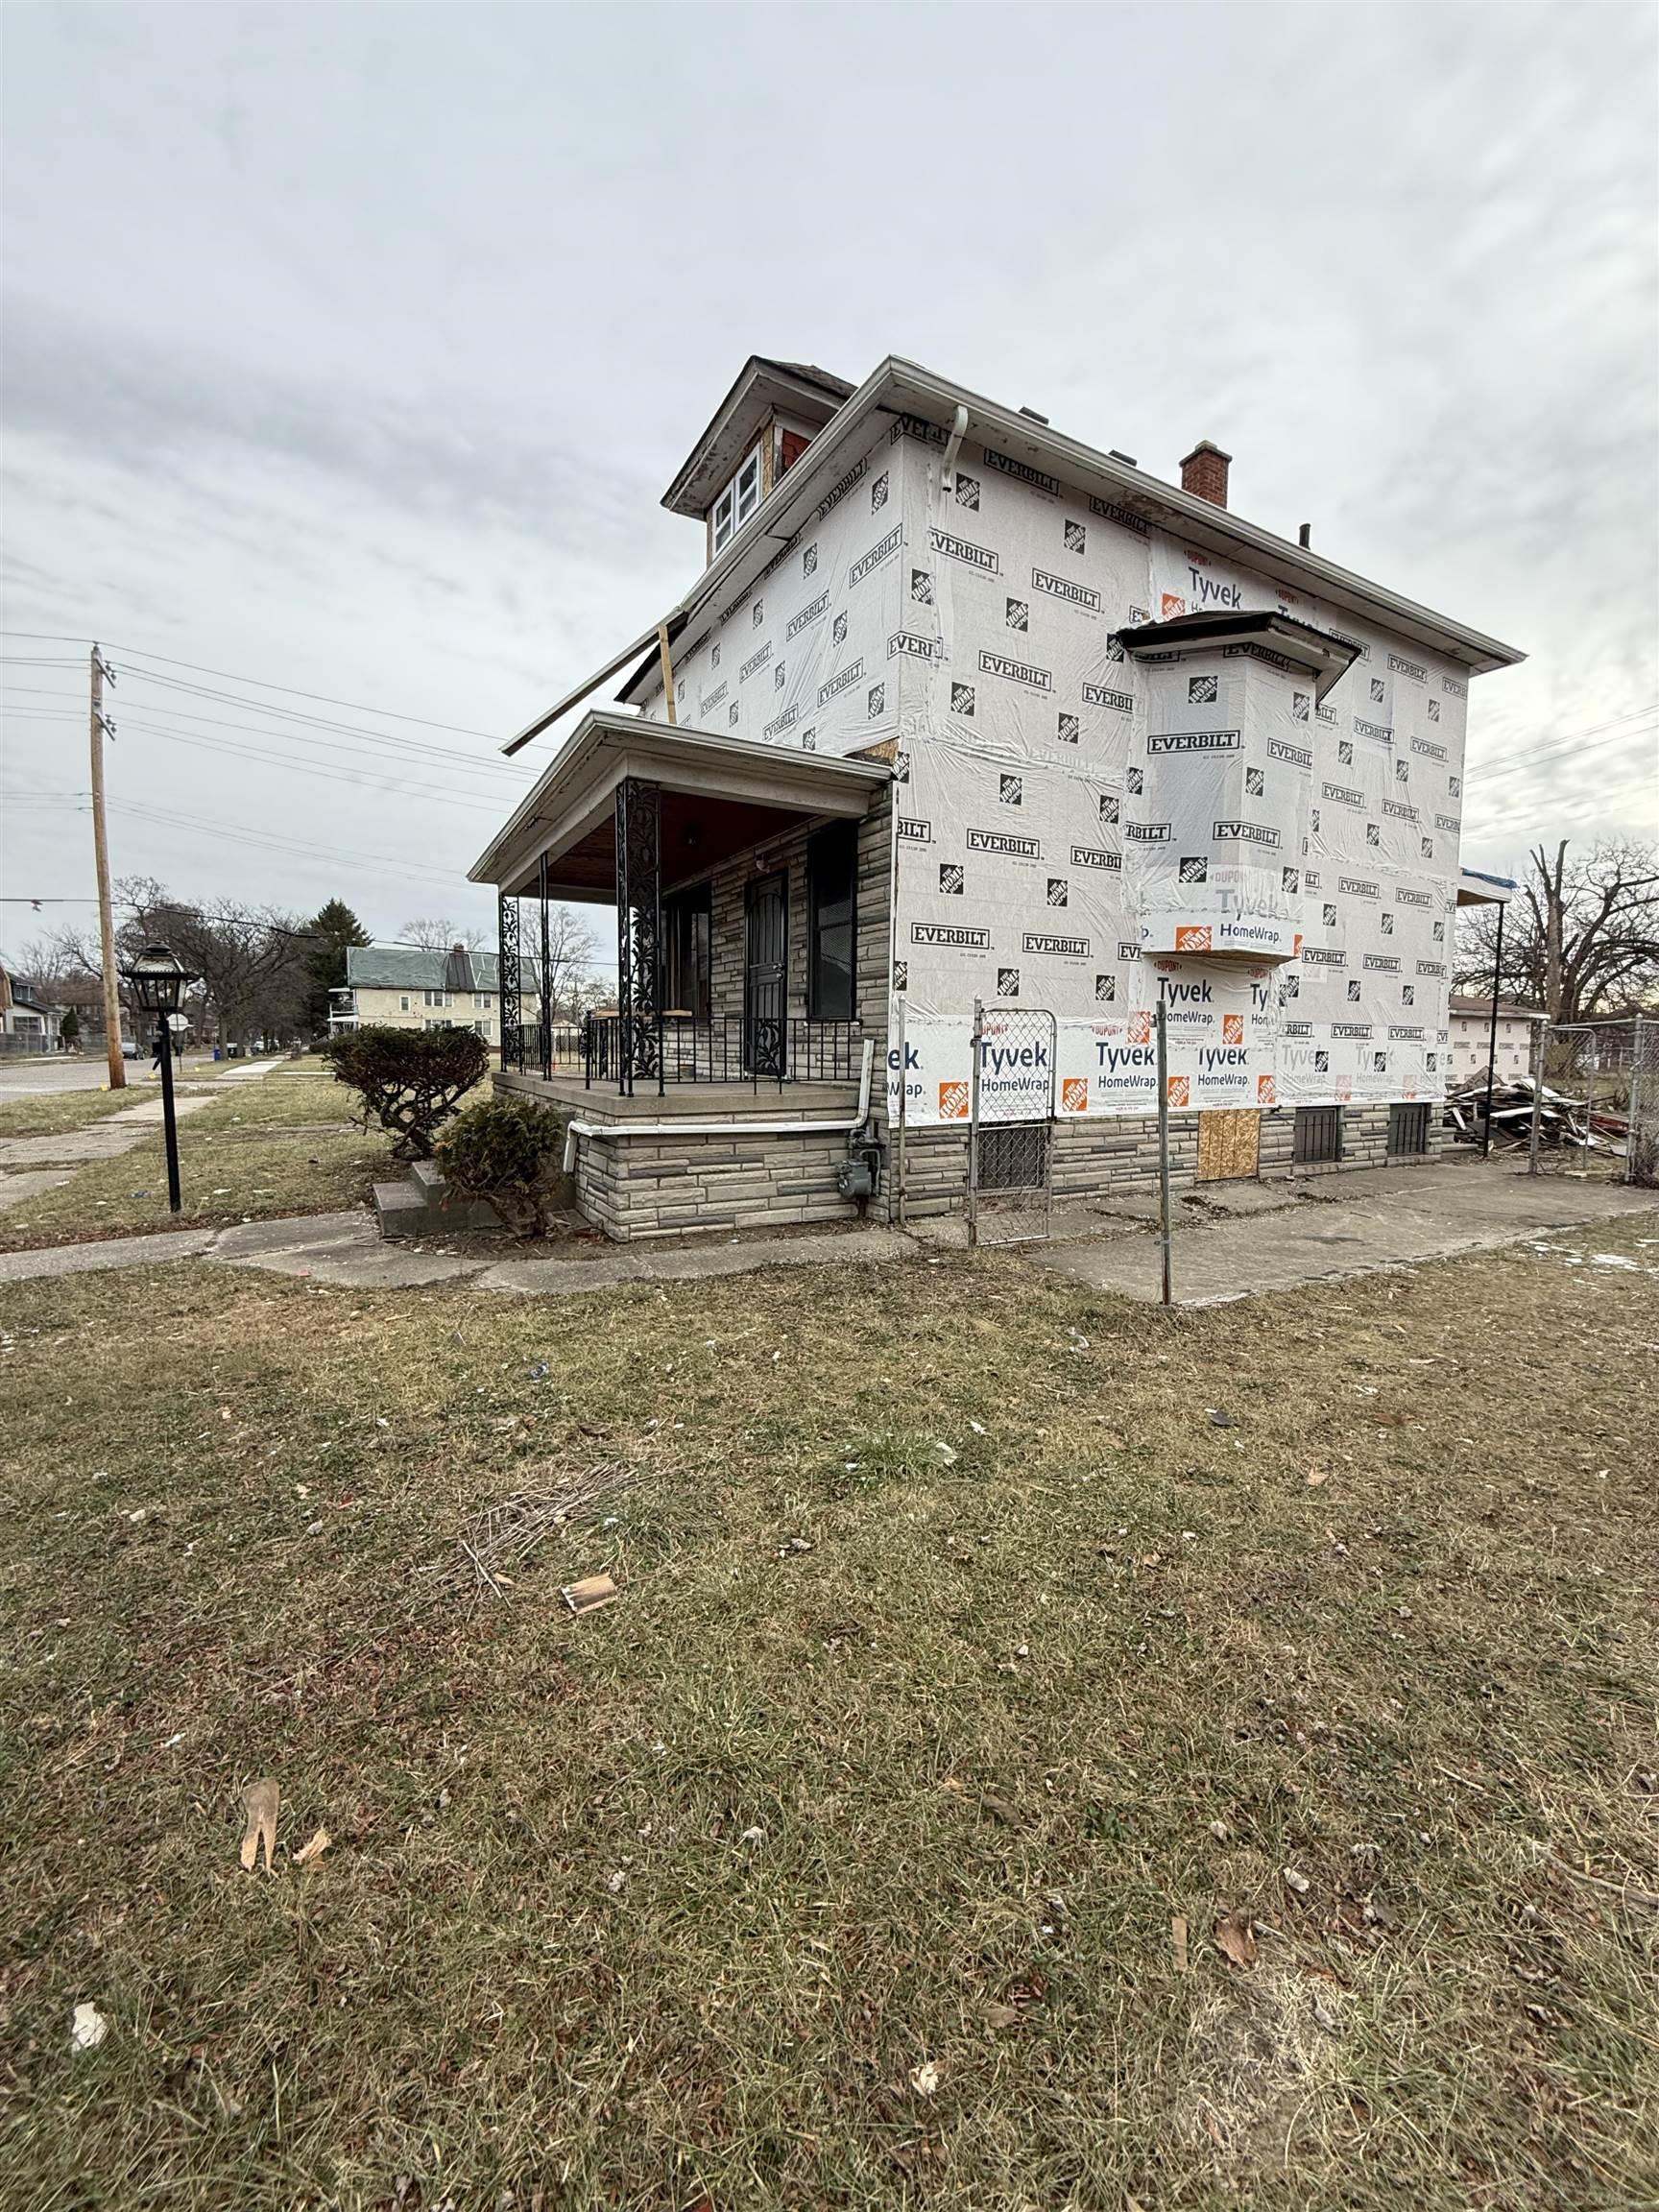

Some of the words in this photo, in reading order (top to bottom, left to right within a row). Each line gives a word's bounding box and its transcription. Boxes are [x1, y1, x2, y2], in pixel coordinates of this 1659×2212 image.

[987, 452, 1054, 491] EVERBILT
[852, 529, 900, 583] EVERBILT
[1035, 572, 1098, 608] EVERBILT
[1189, 566, 1241, 609] Tyvek
[788, 594, 828, 637] EVERBILT
[981, 653, 1049, 686] EVERBILT
[819, 663, 861, 703] EVERBILT
[1189, 677, 1217, 703] HOME
[764, 708, 797, 740] EVERBILT
[1355, 721, 1392, 740] EVERBILT
[1151, 733, 1236, 751] EVERBILT
[1412, 740, 1445, 758] EVERBILT
[1324, 785, 1362, 805] EVERBILT
[1383, 803, 1418, 820] EVERBILT
[970, 833, 1037, 855] EVERBILT
[1216, 825, 1278, 846] EVERBILT
[940, 866, 963, 892] HOME
[1180, 858, 1207, 882] HOME
[1340, 880, 1378, 895] EVERBILT
[1397, 891, 1431, 904] EVERBILT
[914, 926, 987, 946] EVERBILT
[1220, 924, 1280, 943] HomeWrap
[1025, 937, 1087, 954] EVERBILT
[1157, 962, 1179, 972] DUPONT
[1304, 950, 1345, 963] EVERBILT
[1364, 957, 1399, 969] EVERBILT
[998, 970, 1019, 995] HOME
[1158, 977, 1212, 1007] Tyvek
[1163, 1012, 1214, 1024] omeWrap
[1334, 1026, 1370, 1037] EVERBILT
[1390, 1029, 1423, 1038] EVERBILT
[979, 1042, 1047, 1075] Tyvek
[1096, 1043, 1154, 1072] Tyvek
[1199, 1048, 1247, 1070] Tyvek
[982, 1078, 1049, 1093] HomeWrap
[1098, 1075, 1156, 1089] HomeWrap
[1198, 1074, 1248, 1086] HomeWrap
[940, 1083, 968, 1118] HOME
[1063, 1079, 1088, 1111] HOME
